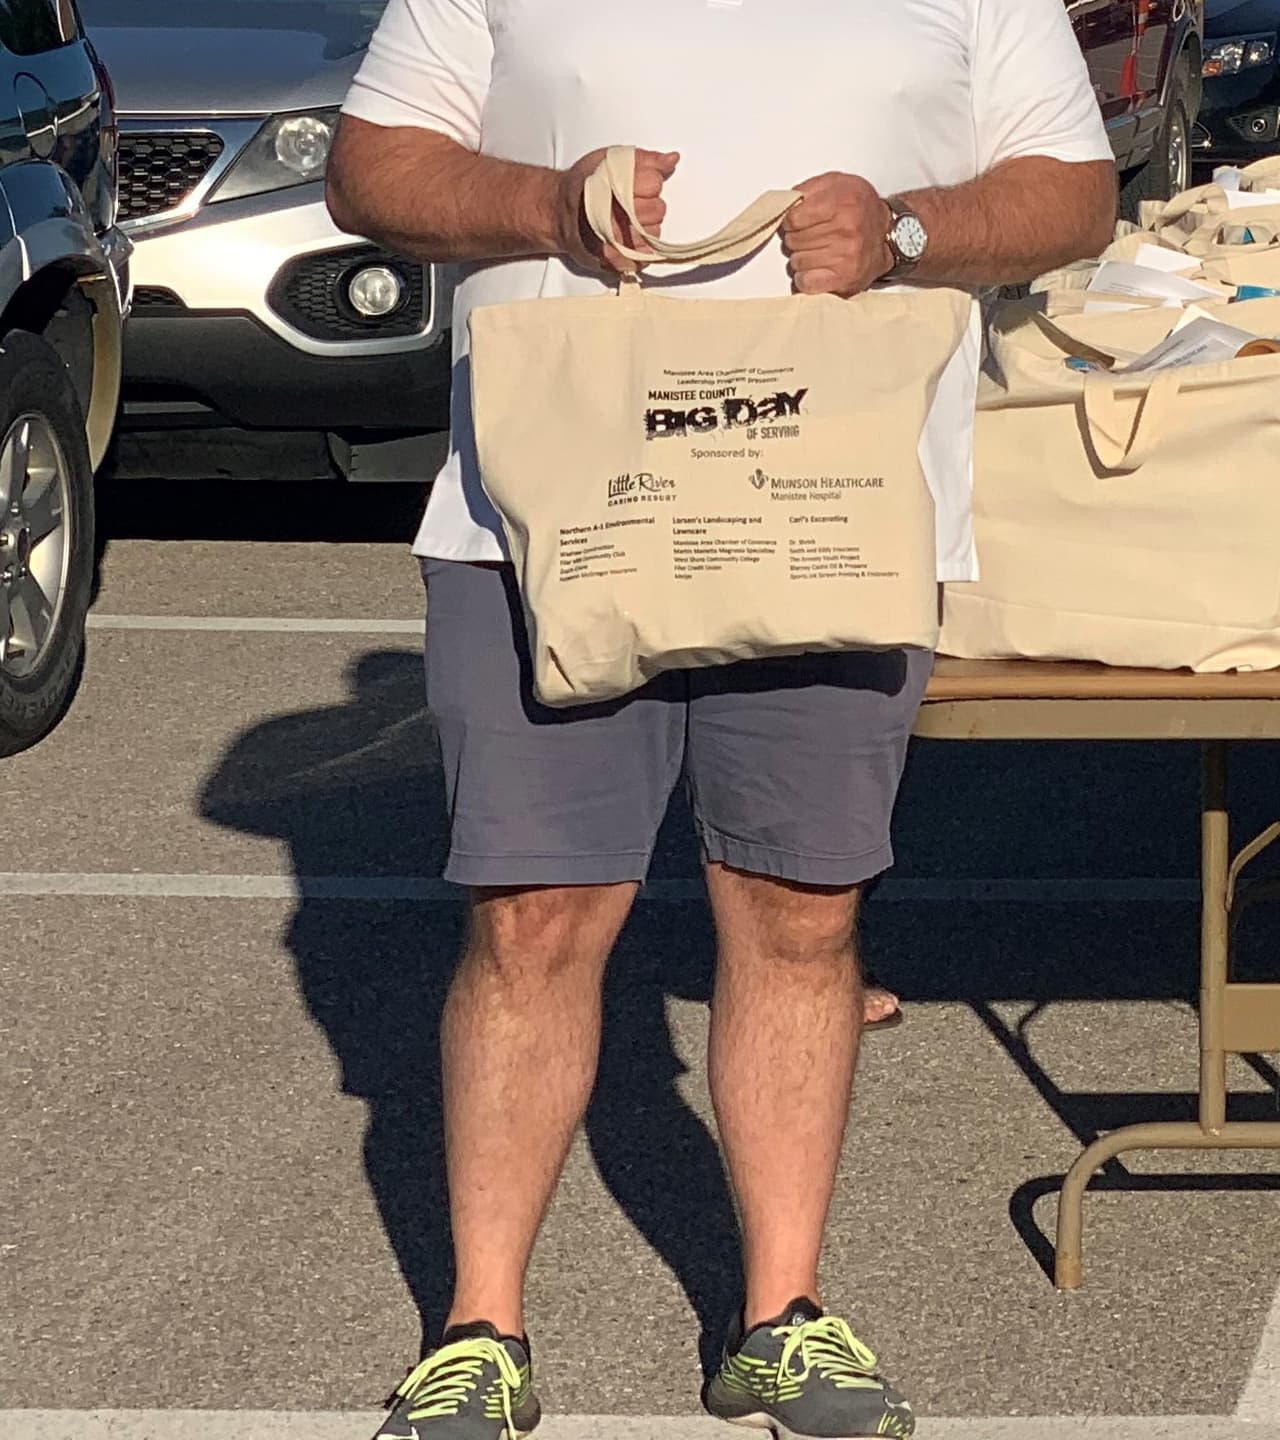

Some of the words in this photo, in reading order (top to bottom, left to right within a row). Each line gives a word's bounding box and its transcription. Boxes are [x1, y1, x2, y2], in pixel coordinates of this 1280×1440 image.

[648, 390, 697, 401] MANISTEE
[699, 387, 737, 400] COUNTY
[644, 407, 718, 440] BIG
[747, 428, 758, 440] OF
[761, 425, 800, 439] SERVING
[691, 448, 745, 459] Sponsored
[748, 448, 764, 459] by:
[608, 473, 636, 498] Little
[636, 473, 676, 492] River
[771, 478, 817, 489] MUNSON
[820, 477, 885, 489] HEALTHCARE
[608, 495, 639, 507] CASINO
[641, 494, 677, 502] RESORT
[771, 491, 807, 501] Manistee
[809, 491, 842, 502] Hospital
[560, 526, 592, 535] Northern
[605, 517, 655, 529] Environmental
[748, 516, 762, 524] and
[560, 538, 588, 546] Services
